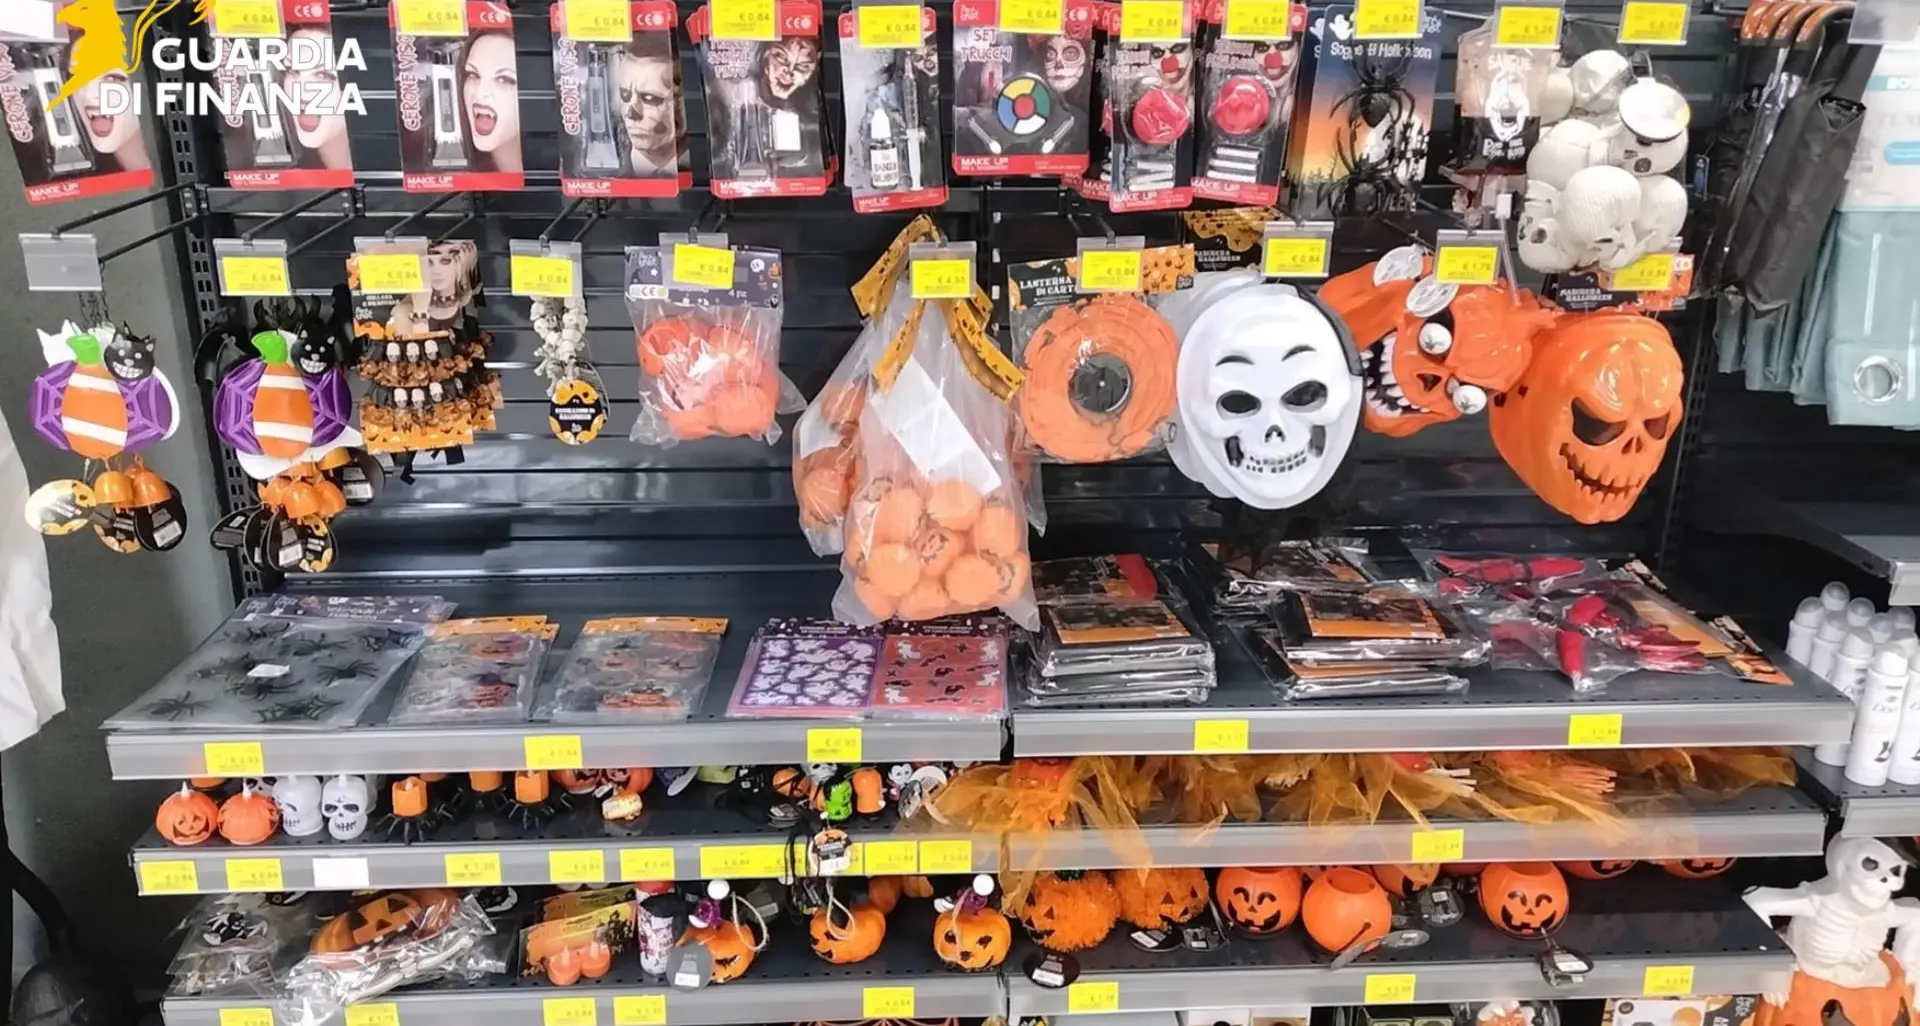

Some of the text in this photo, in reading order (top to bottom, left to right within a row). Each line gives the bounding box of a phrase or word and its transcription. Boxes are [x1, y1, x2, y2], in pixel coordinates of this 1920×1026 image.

[972, 27, 997, 44] SET
[960, 45, 1012, 63] TRUCCHI
[1330, 41, 1363, 60] Sogo
[399, 73, 421, 131] CERONE
[560, 77, 581, 135] CERONE
[961, 157, 1009, 166] MAKE UP
[233, 172, 279, 181] MAKE UP
[407, 176, 453, 185] MAKE UP
[30, 183, 79, 196] MAKE UP
[567, 182, 594, 190] MAKE
[1020, 276, 1072, 290] LANTERNA
[1036, 284, 1077, 297] DI CART
